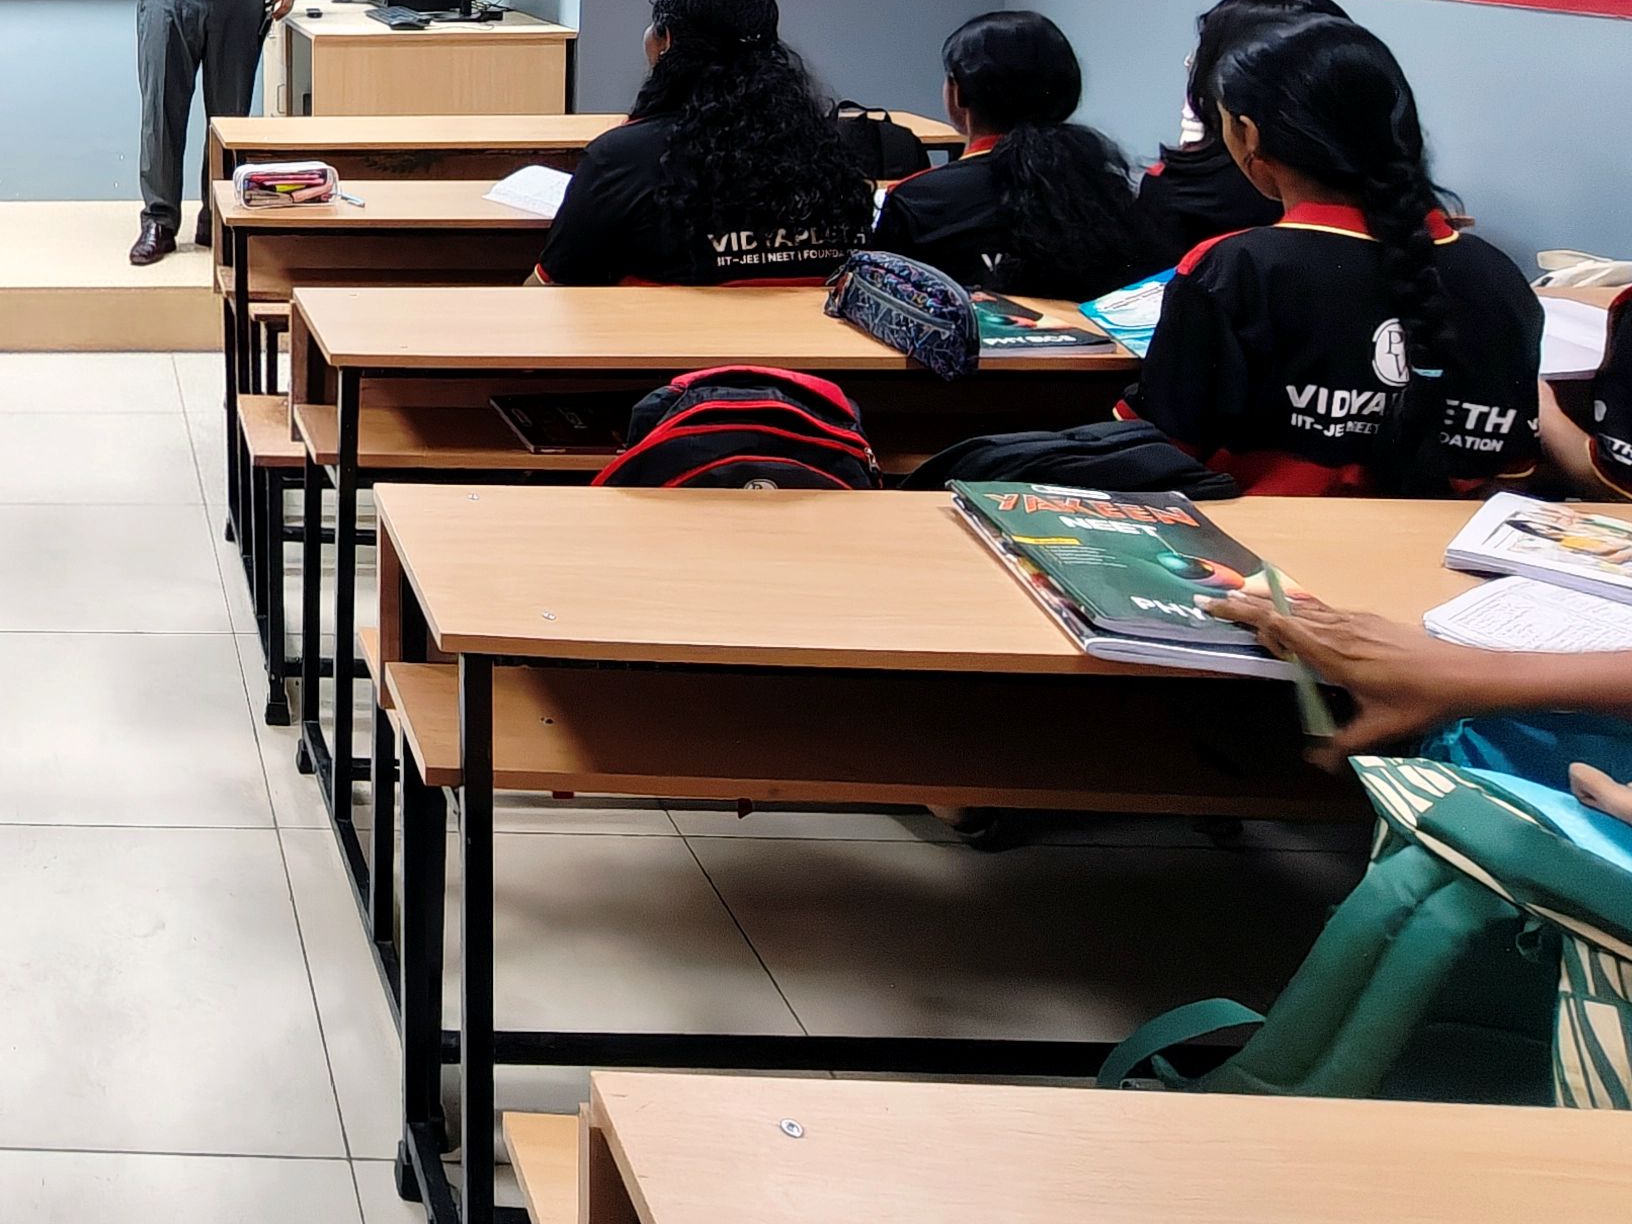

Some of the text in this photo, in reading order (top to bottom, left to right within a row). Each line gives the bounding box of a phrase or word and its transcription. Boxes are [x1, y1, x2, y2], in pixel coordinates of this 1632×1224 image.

[717, 249, 846, 267] IIT-JEE NEET FOUND
[1291, 413, 1345, 437] IIT-JE
[983, 493, 1201, 527] YAKEEN
[1058, 515, 1157, 537] NEET
